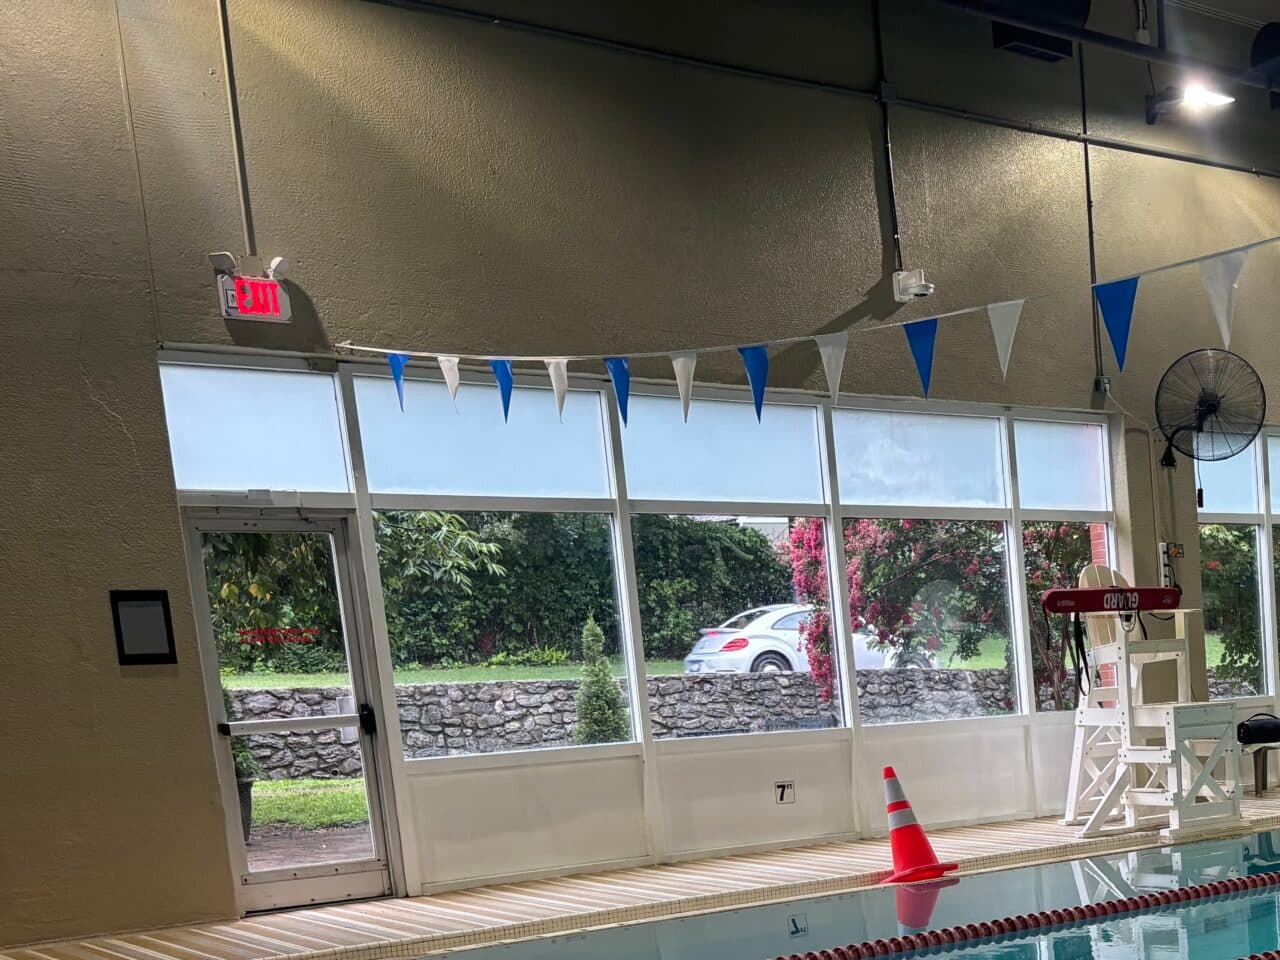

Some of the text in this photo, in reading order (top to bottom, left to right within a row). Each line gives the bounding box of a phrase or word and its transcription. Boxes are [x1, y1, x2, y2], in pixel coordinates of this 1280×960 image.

[235, 279, 280, 316] EXIT
[1103, 591, 1139, 609] GUARD
[776, 784, 786, 801] 7
